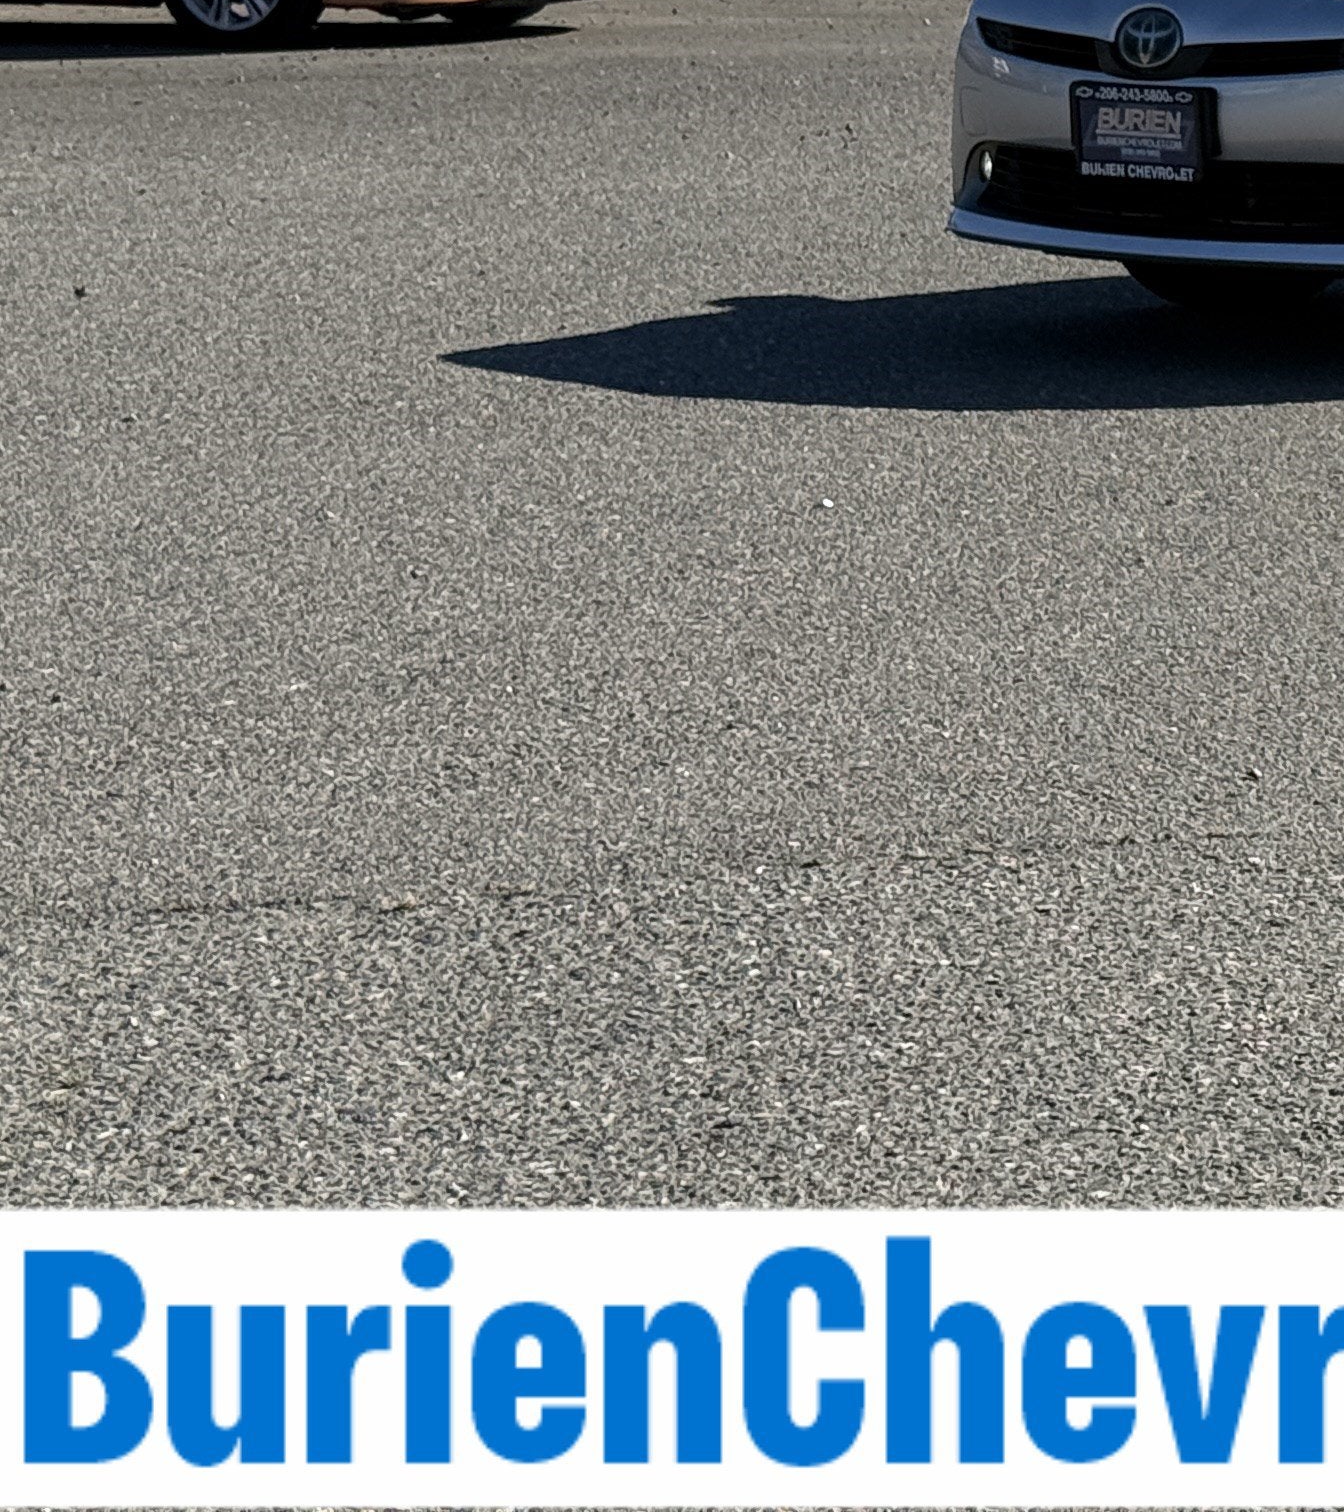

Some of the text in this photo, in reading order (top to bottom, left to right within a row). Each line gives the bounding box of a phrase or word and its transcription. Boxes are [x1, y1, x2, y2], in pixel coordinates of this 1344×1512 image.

[1098, 107, 1182, 134] BURIEN
[1081, 161, 1195, 182] BURIEN CHEVROLET
